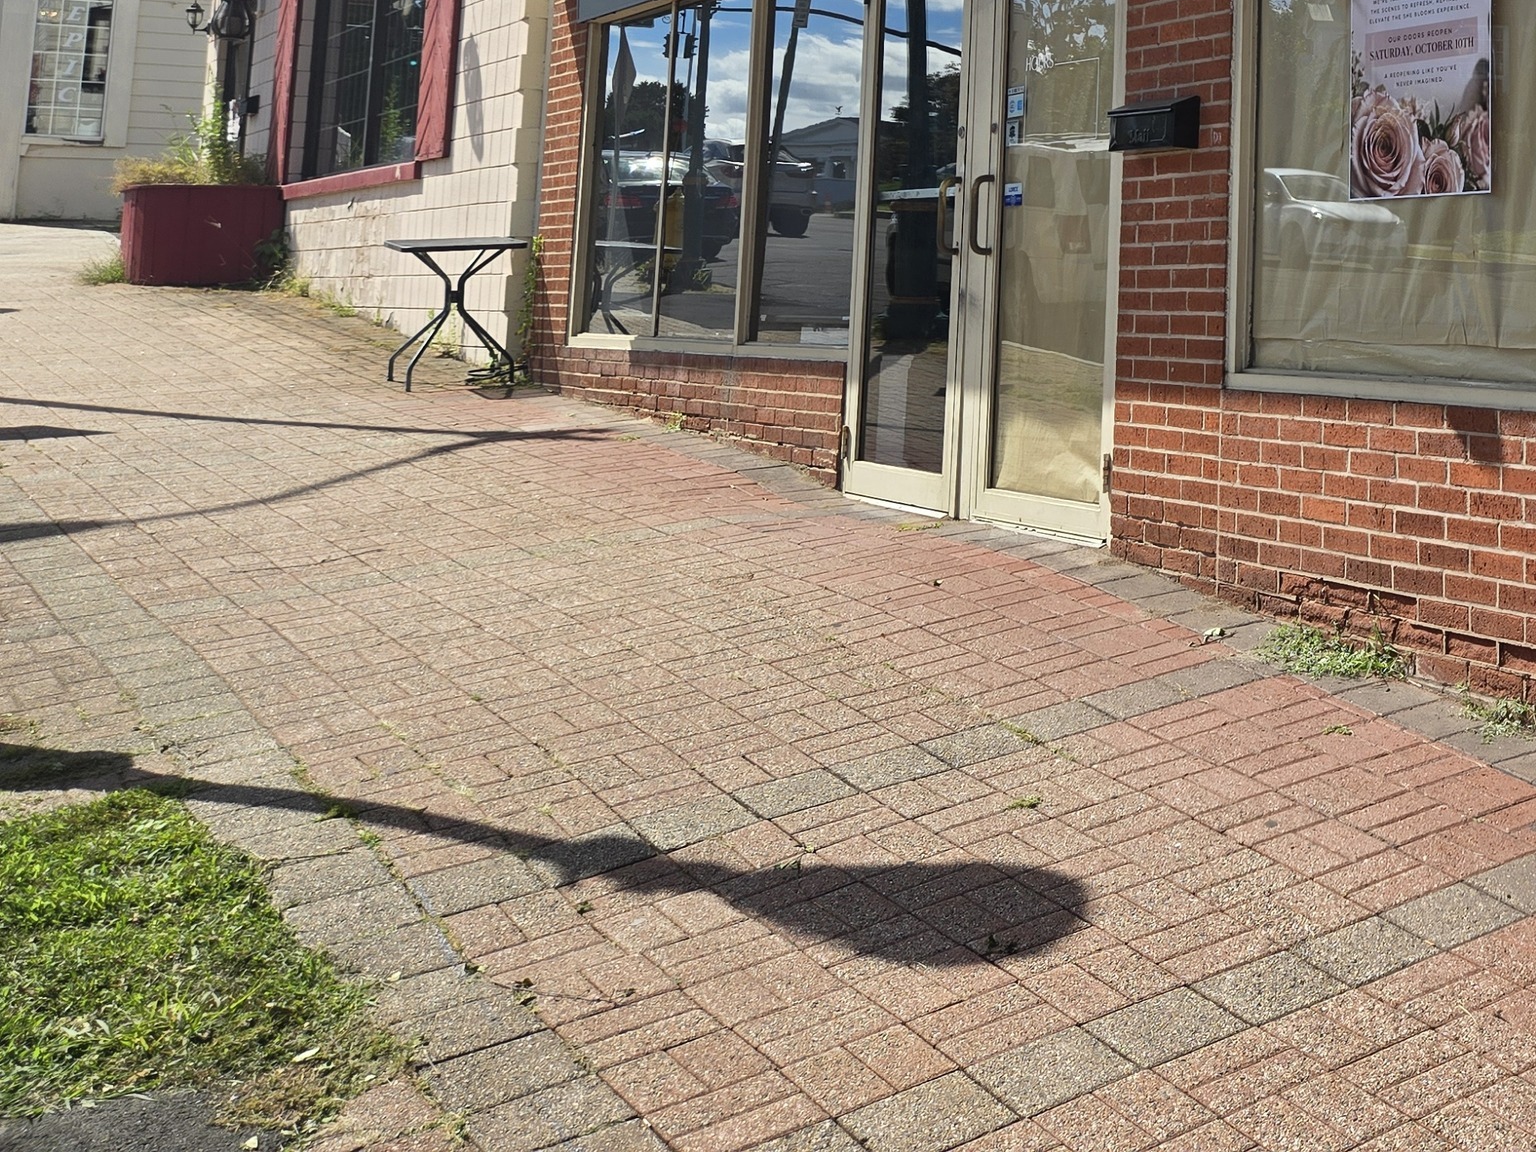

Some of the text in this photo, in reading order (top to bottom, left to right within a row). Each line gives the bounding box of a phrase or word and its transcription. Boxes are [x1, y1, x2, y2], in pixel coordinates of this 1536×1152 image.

[1369, 16, 1390, 24] ELEVATE
[1402, 12, 1412, 20] SHE
[1414, 9, 1435, 18] BLOOMS
[1381, 5, 1400, 13] SCENES
[1388, 28, 1453, 43] OUR DOORS REOPEN
[58, 6, 85, 102] EPIC
[1369, 36, 1474, 61] SATURDAY, OCTOBER 10TH
[1389, 69, 1419, 78] REOPENING
[1422, 67, 1434, 75] LIKE
